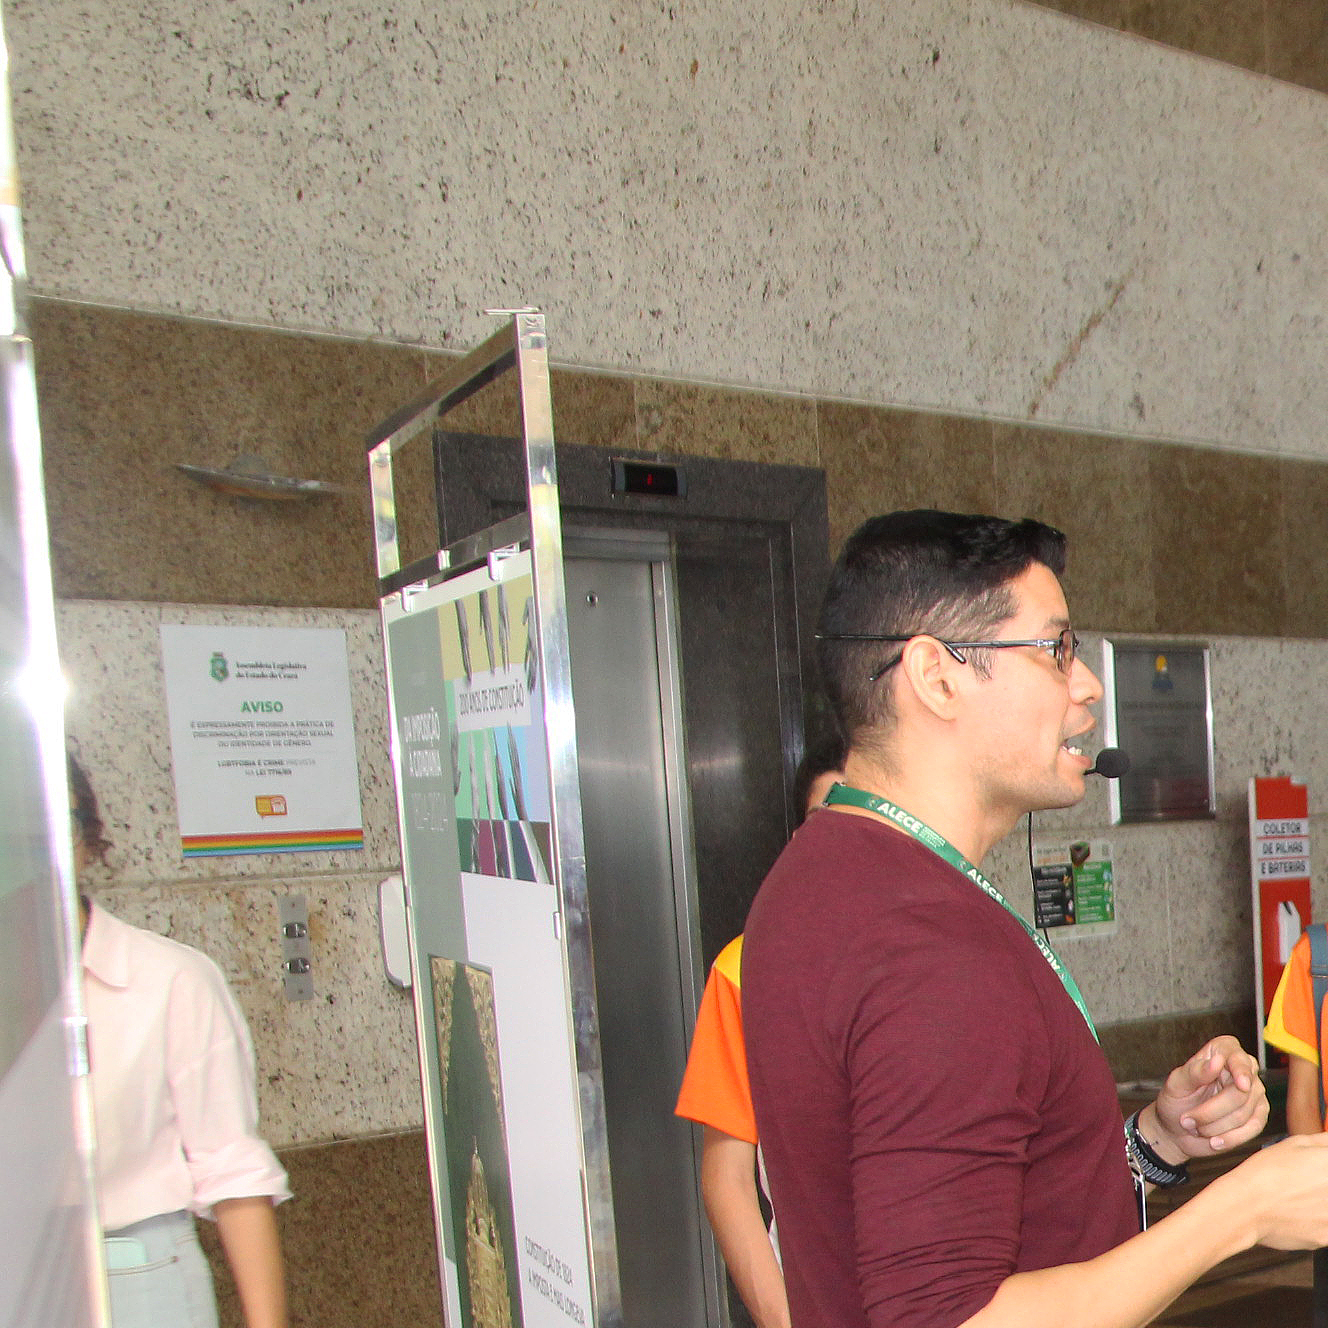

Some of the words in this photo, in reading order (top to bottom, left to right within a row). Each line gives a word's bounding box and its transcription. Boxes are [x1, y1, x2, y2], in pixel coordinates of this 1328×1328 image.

[241, 701, 284, 713] AVISO
[877, 801, 923, 834] ALECE
[1263, 822, 1301, 835] COLETOR
[1262, 843, 1273, 854] DE
[1275, 841, 1303, 854] PILHAS
[1261, 862, 1266, 874] E
[1268, 860, 1306, 874] BATERIAS
[967, 868, 1003, 904] ALECE
